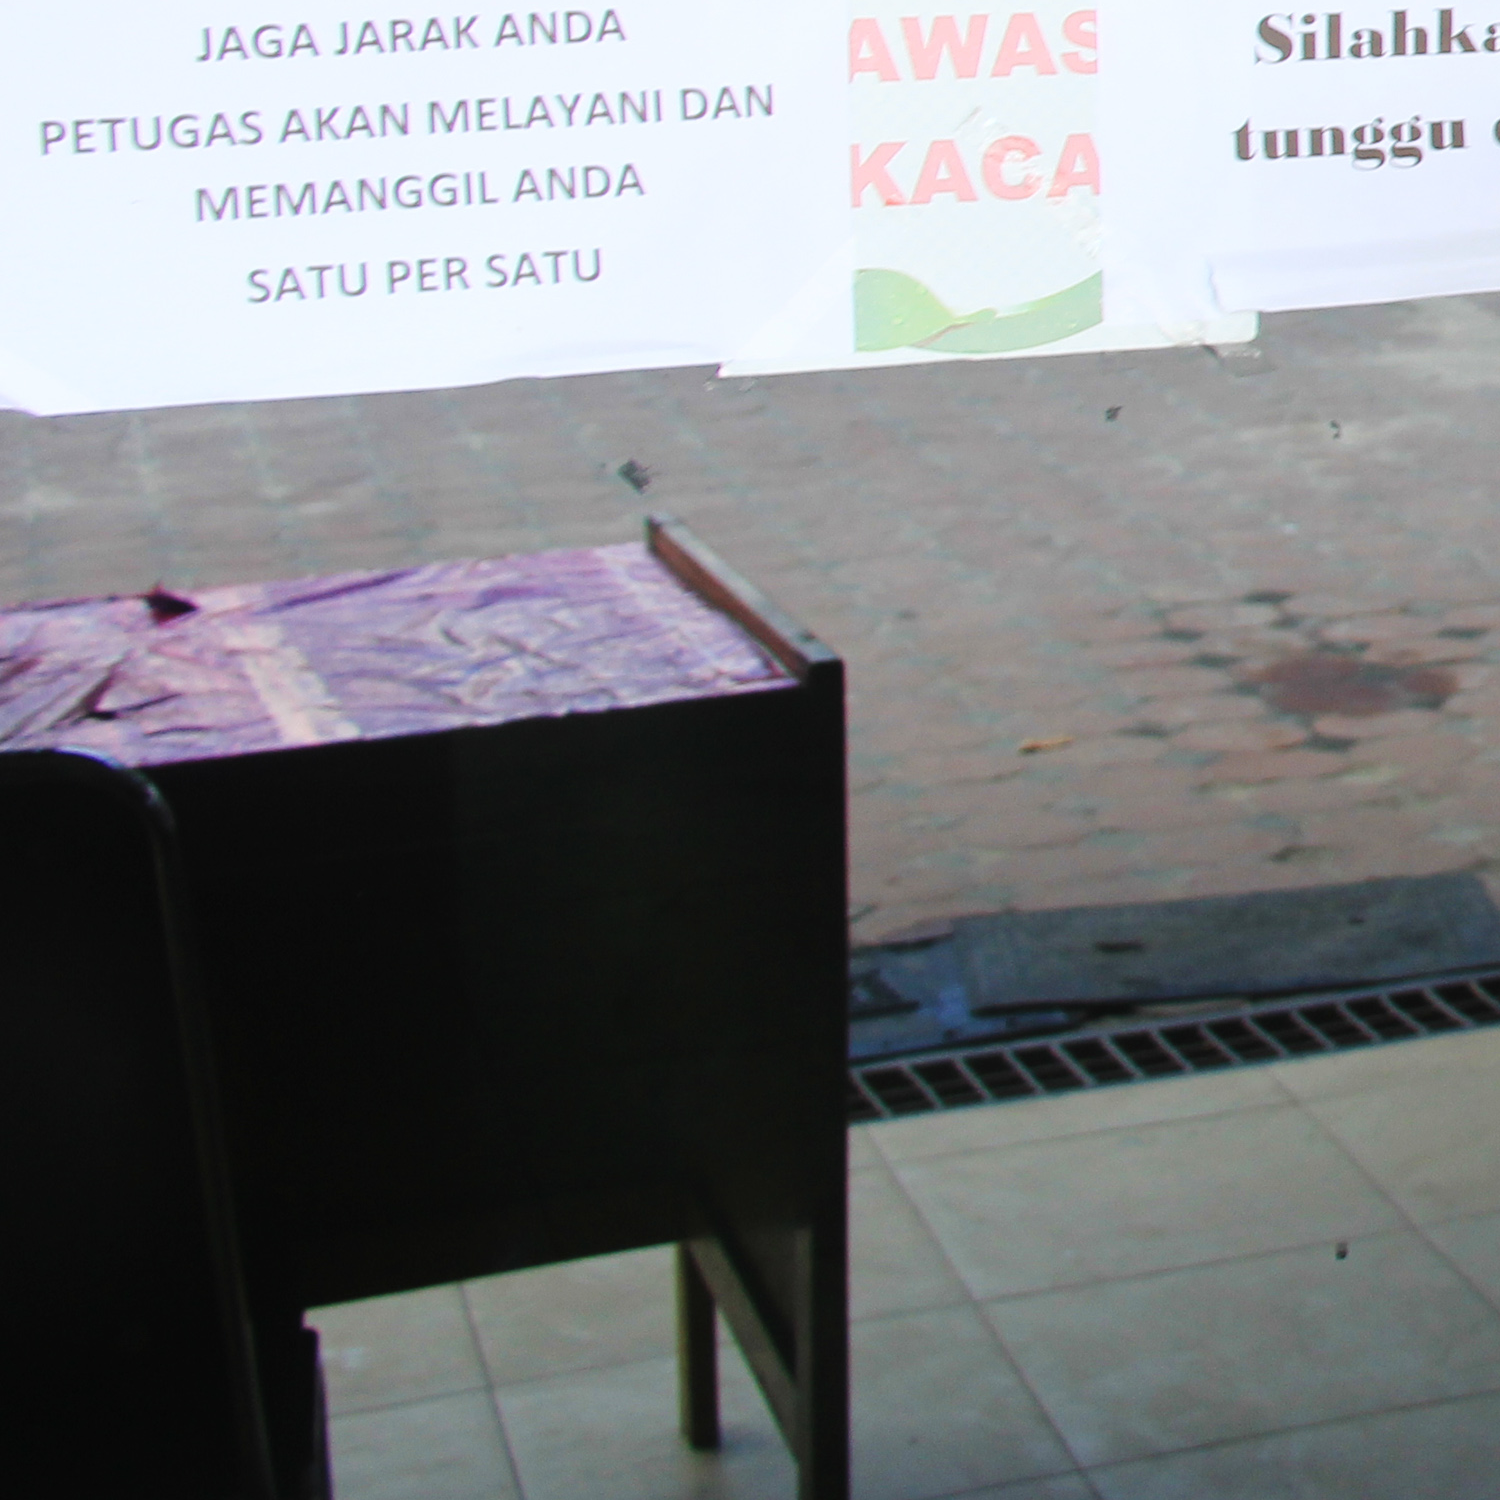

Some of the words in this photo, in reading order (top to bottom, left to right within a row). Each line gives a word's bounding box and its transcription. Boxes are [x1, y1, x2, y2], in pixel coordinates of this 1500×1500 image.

[195, 23, 321, 64] JAGA
[333, 14, 481, 57] JARAK
[493, 8, 628, 49] ANDA
[848, 9, 1099, 83] AWAS
[39, 110, 265, 157] PETUGAS
[278, 101, 411, 145] AKAN
[427, 88, 664, 135] MELAYANI
[680, 83, 775, 123] DAN
[1232, 114, 1469, 170] tunggu
[194, 170, 500, 223] MEMANGGIL
[512, 162, 647, 203] ANDA
[850, 132, 1102, 209] KACA
[246, 261, 370, 305] SATU
[386, 255, 472, 295] PER
[484, 247, 604, 290] SATU
